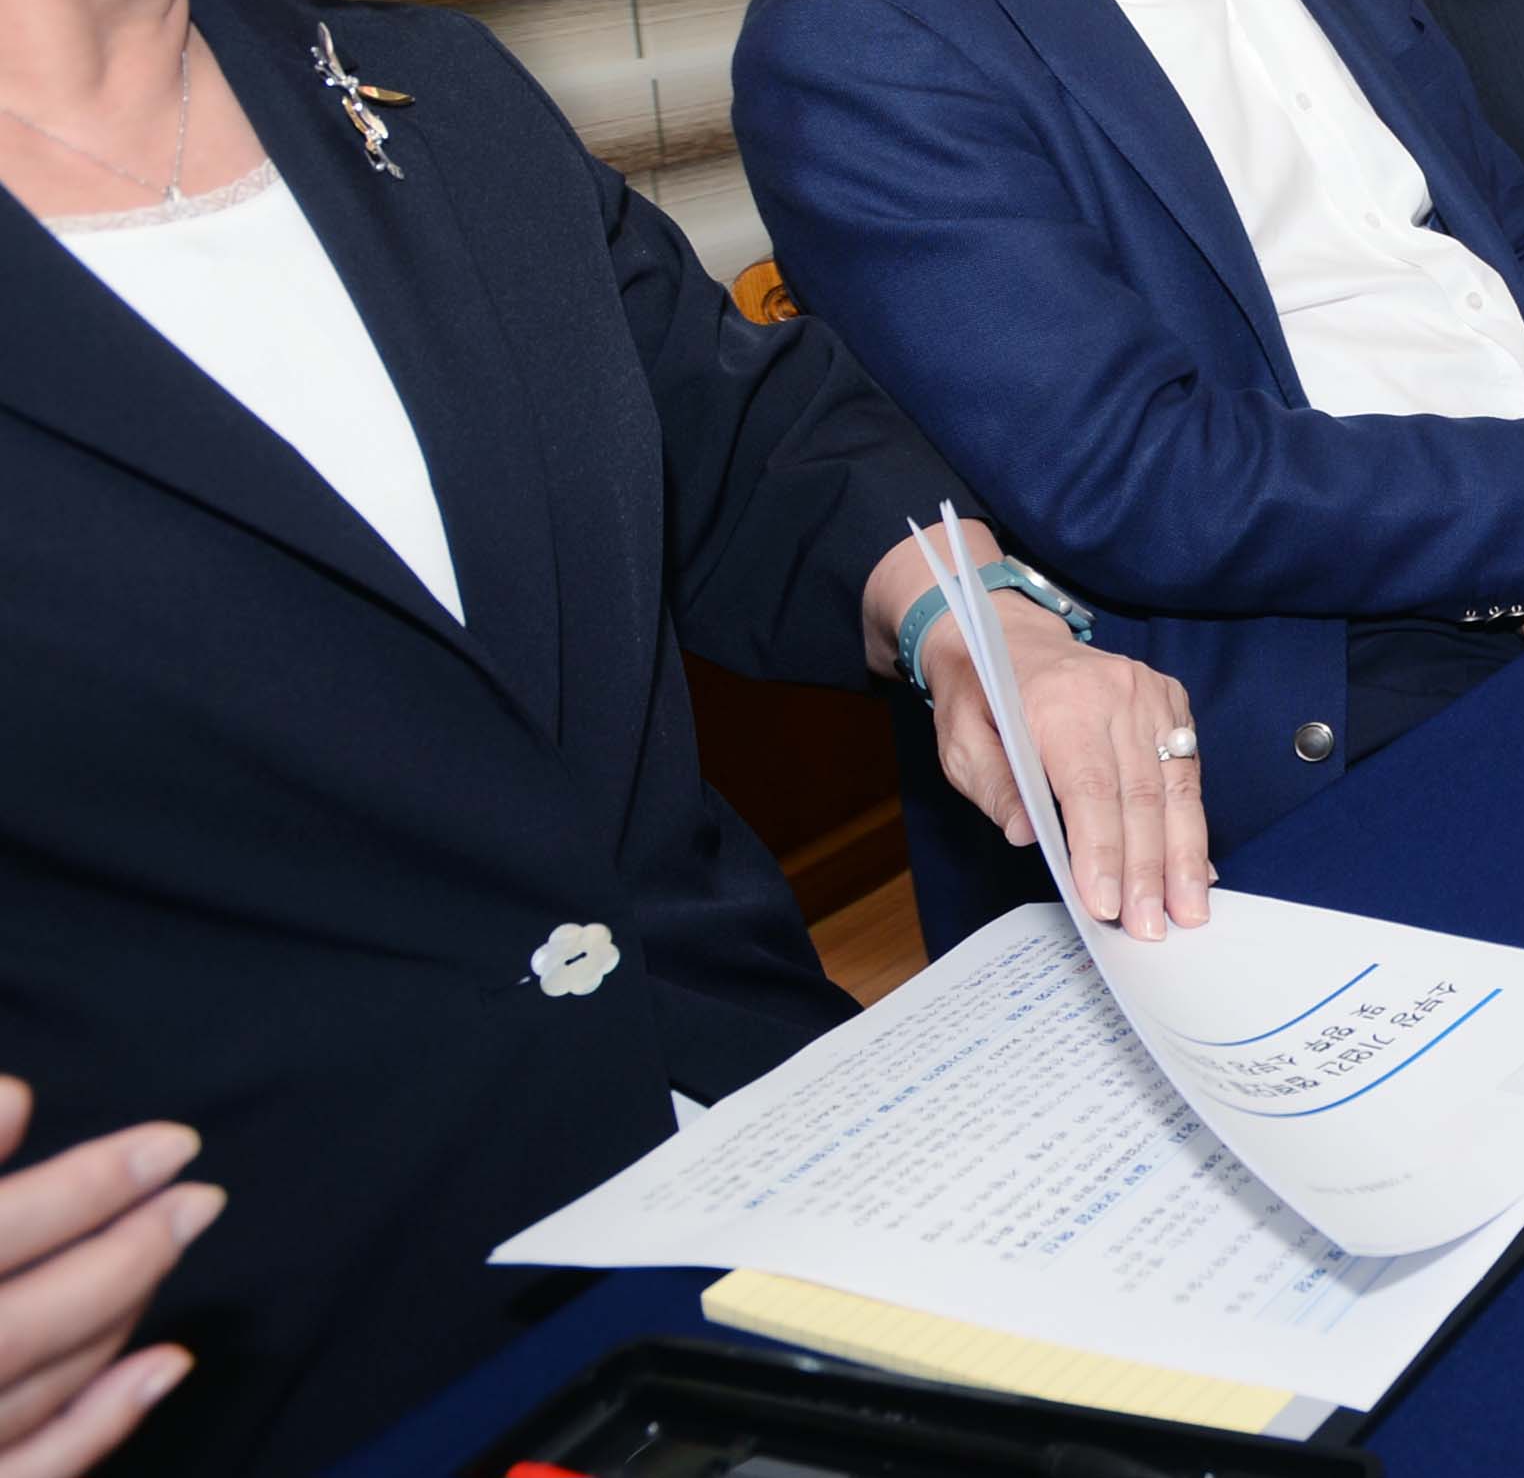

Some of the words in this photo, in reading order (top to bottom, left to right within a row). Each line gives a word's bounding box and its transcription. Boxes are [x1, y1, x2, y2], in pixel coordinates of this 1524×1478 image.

[1350, 1003, 1386, 1020] 및
[1391, 981, 1457, 1028] 소부장
[1304, 1025, 1356, 1053] 향후
[1317, 1034, 1396, 1076] 기업간
